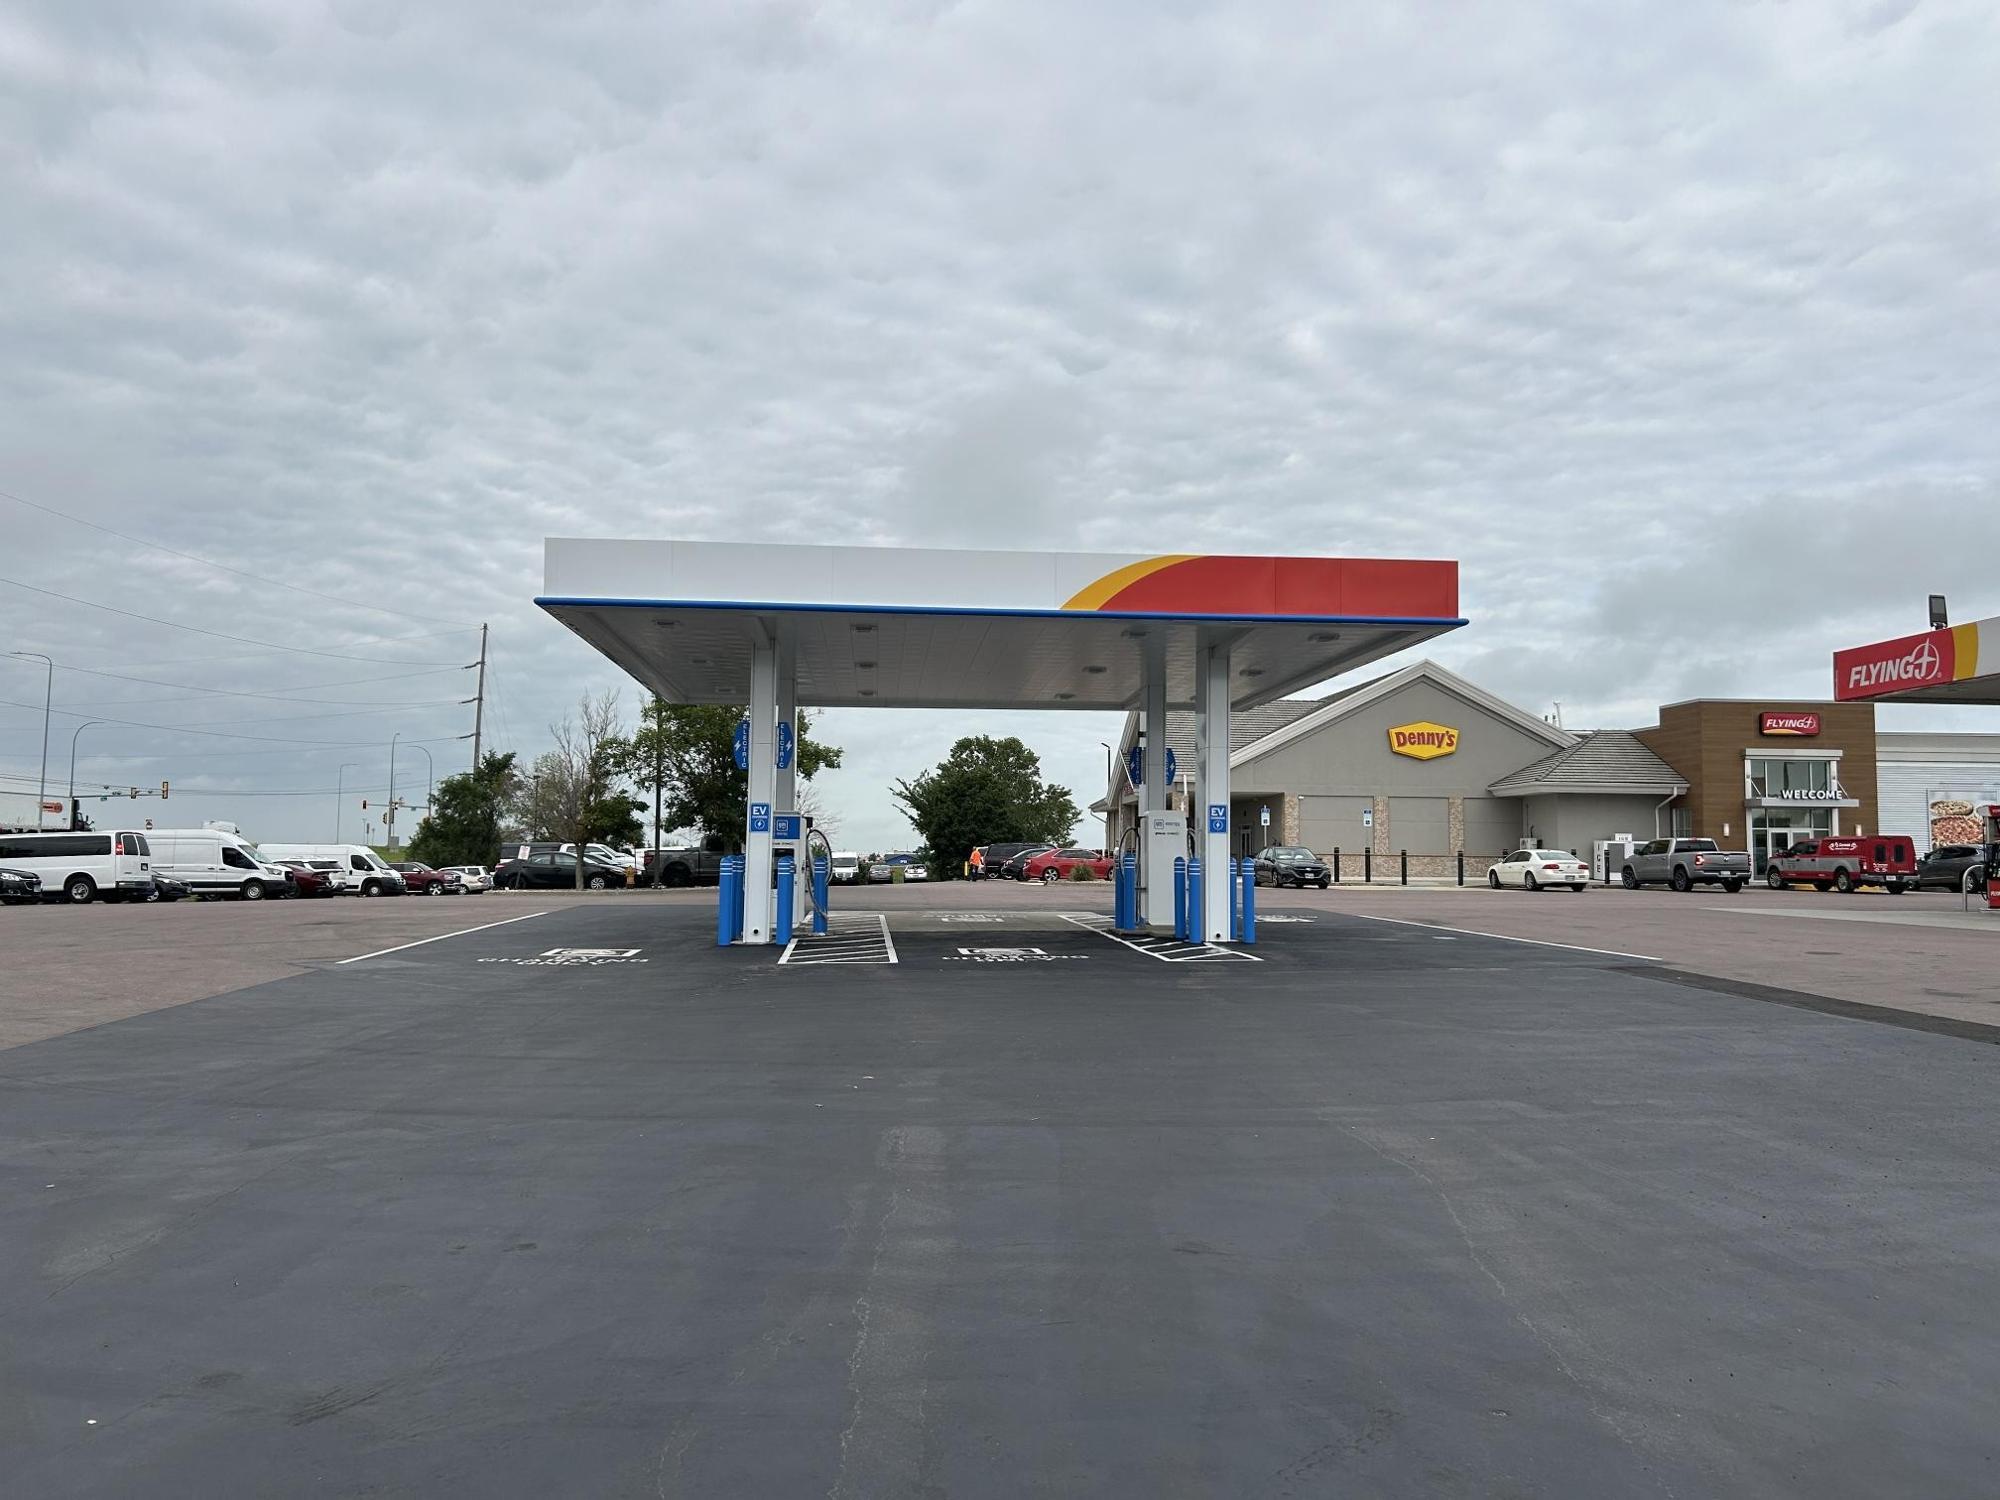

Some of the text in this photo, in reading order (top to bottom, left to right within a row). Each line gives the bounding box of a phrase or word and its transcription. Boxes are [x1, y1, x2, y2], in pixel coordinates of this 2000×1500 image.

[1395, 731, 1455, 748] Denny's
[1782, 790, 1843, 799] WELCOME
[752, 806, 767, 815] EV
[1210, 807, 1225, 816] EV
